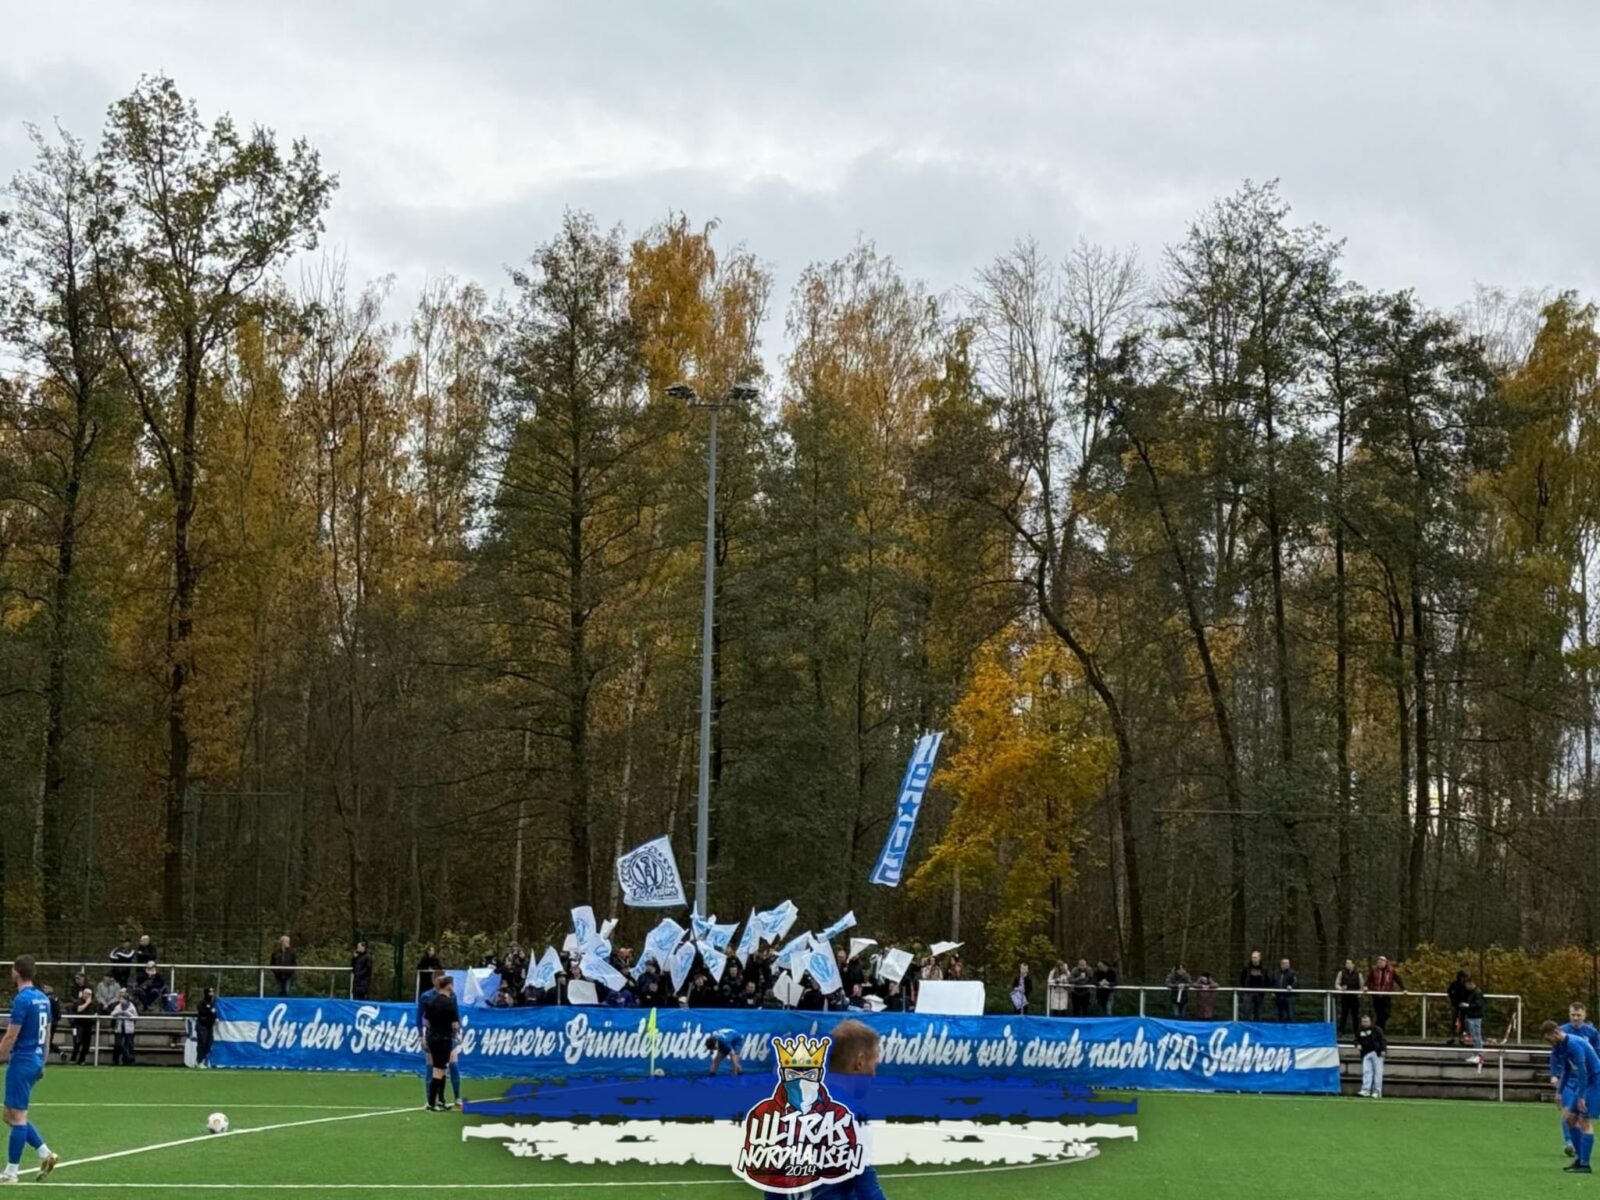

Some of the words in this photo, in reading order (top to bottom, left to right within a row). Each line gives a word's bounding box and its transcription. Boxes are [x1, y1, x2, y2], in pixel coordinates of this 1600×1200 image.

[260, 1003, 297, 1050] In
[301, 1008, 344, 1048] den
[351, 1006, 427, 1054] Farbe
[480, 1026, 555, 1057] unsere
[564, 1013, 718, 1064] Gründerväte
[740, 1033, 771, 1060] ns
[976, 1025, 1018, 1067] wir
[1022, 1028, 1084, 1069] auch
[1088, 1026, 1149, 1069] nach
[1155, 1032, 1199, 1071] 120
[1202, 1027, 1293, 1077] Jahren
